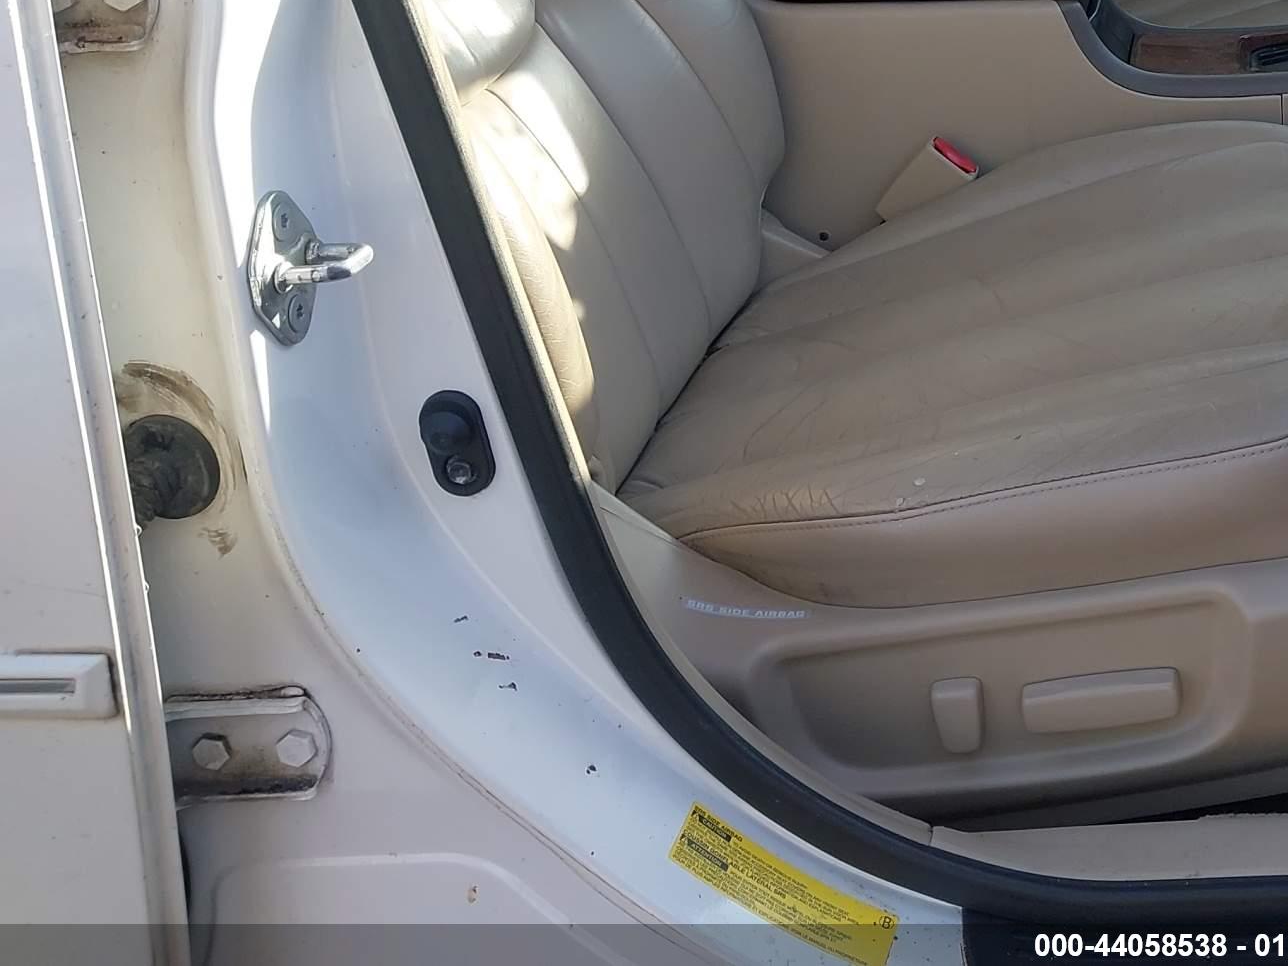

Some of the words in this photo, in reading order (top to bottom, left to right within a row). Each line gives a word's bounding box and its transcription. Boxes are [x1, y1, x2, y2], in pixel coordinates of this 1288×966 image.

[719, 605, 750, 617] SIDE
[754, 609, 806, 619] AIRBAG
[701, 818, 727, 838] CAUTION
[706, 814, 720, 826] SIDE
[720, 824, 743, 842] AIRBAG
[682, 828, 710, 849] COUSSIN
[745, 870, 774, 891] LATERAL
[773, 888, 787, 899] SRS
[690, 842, 722, 866] ATTENTION
